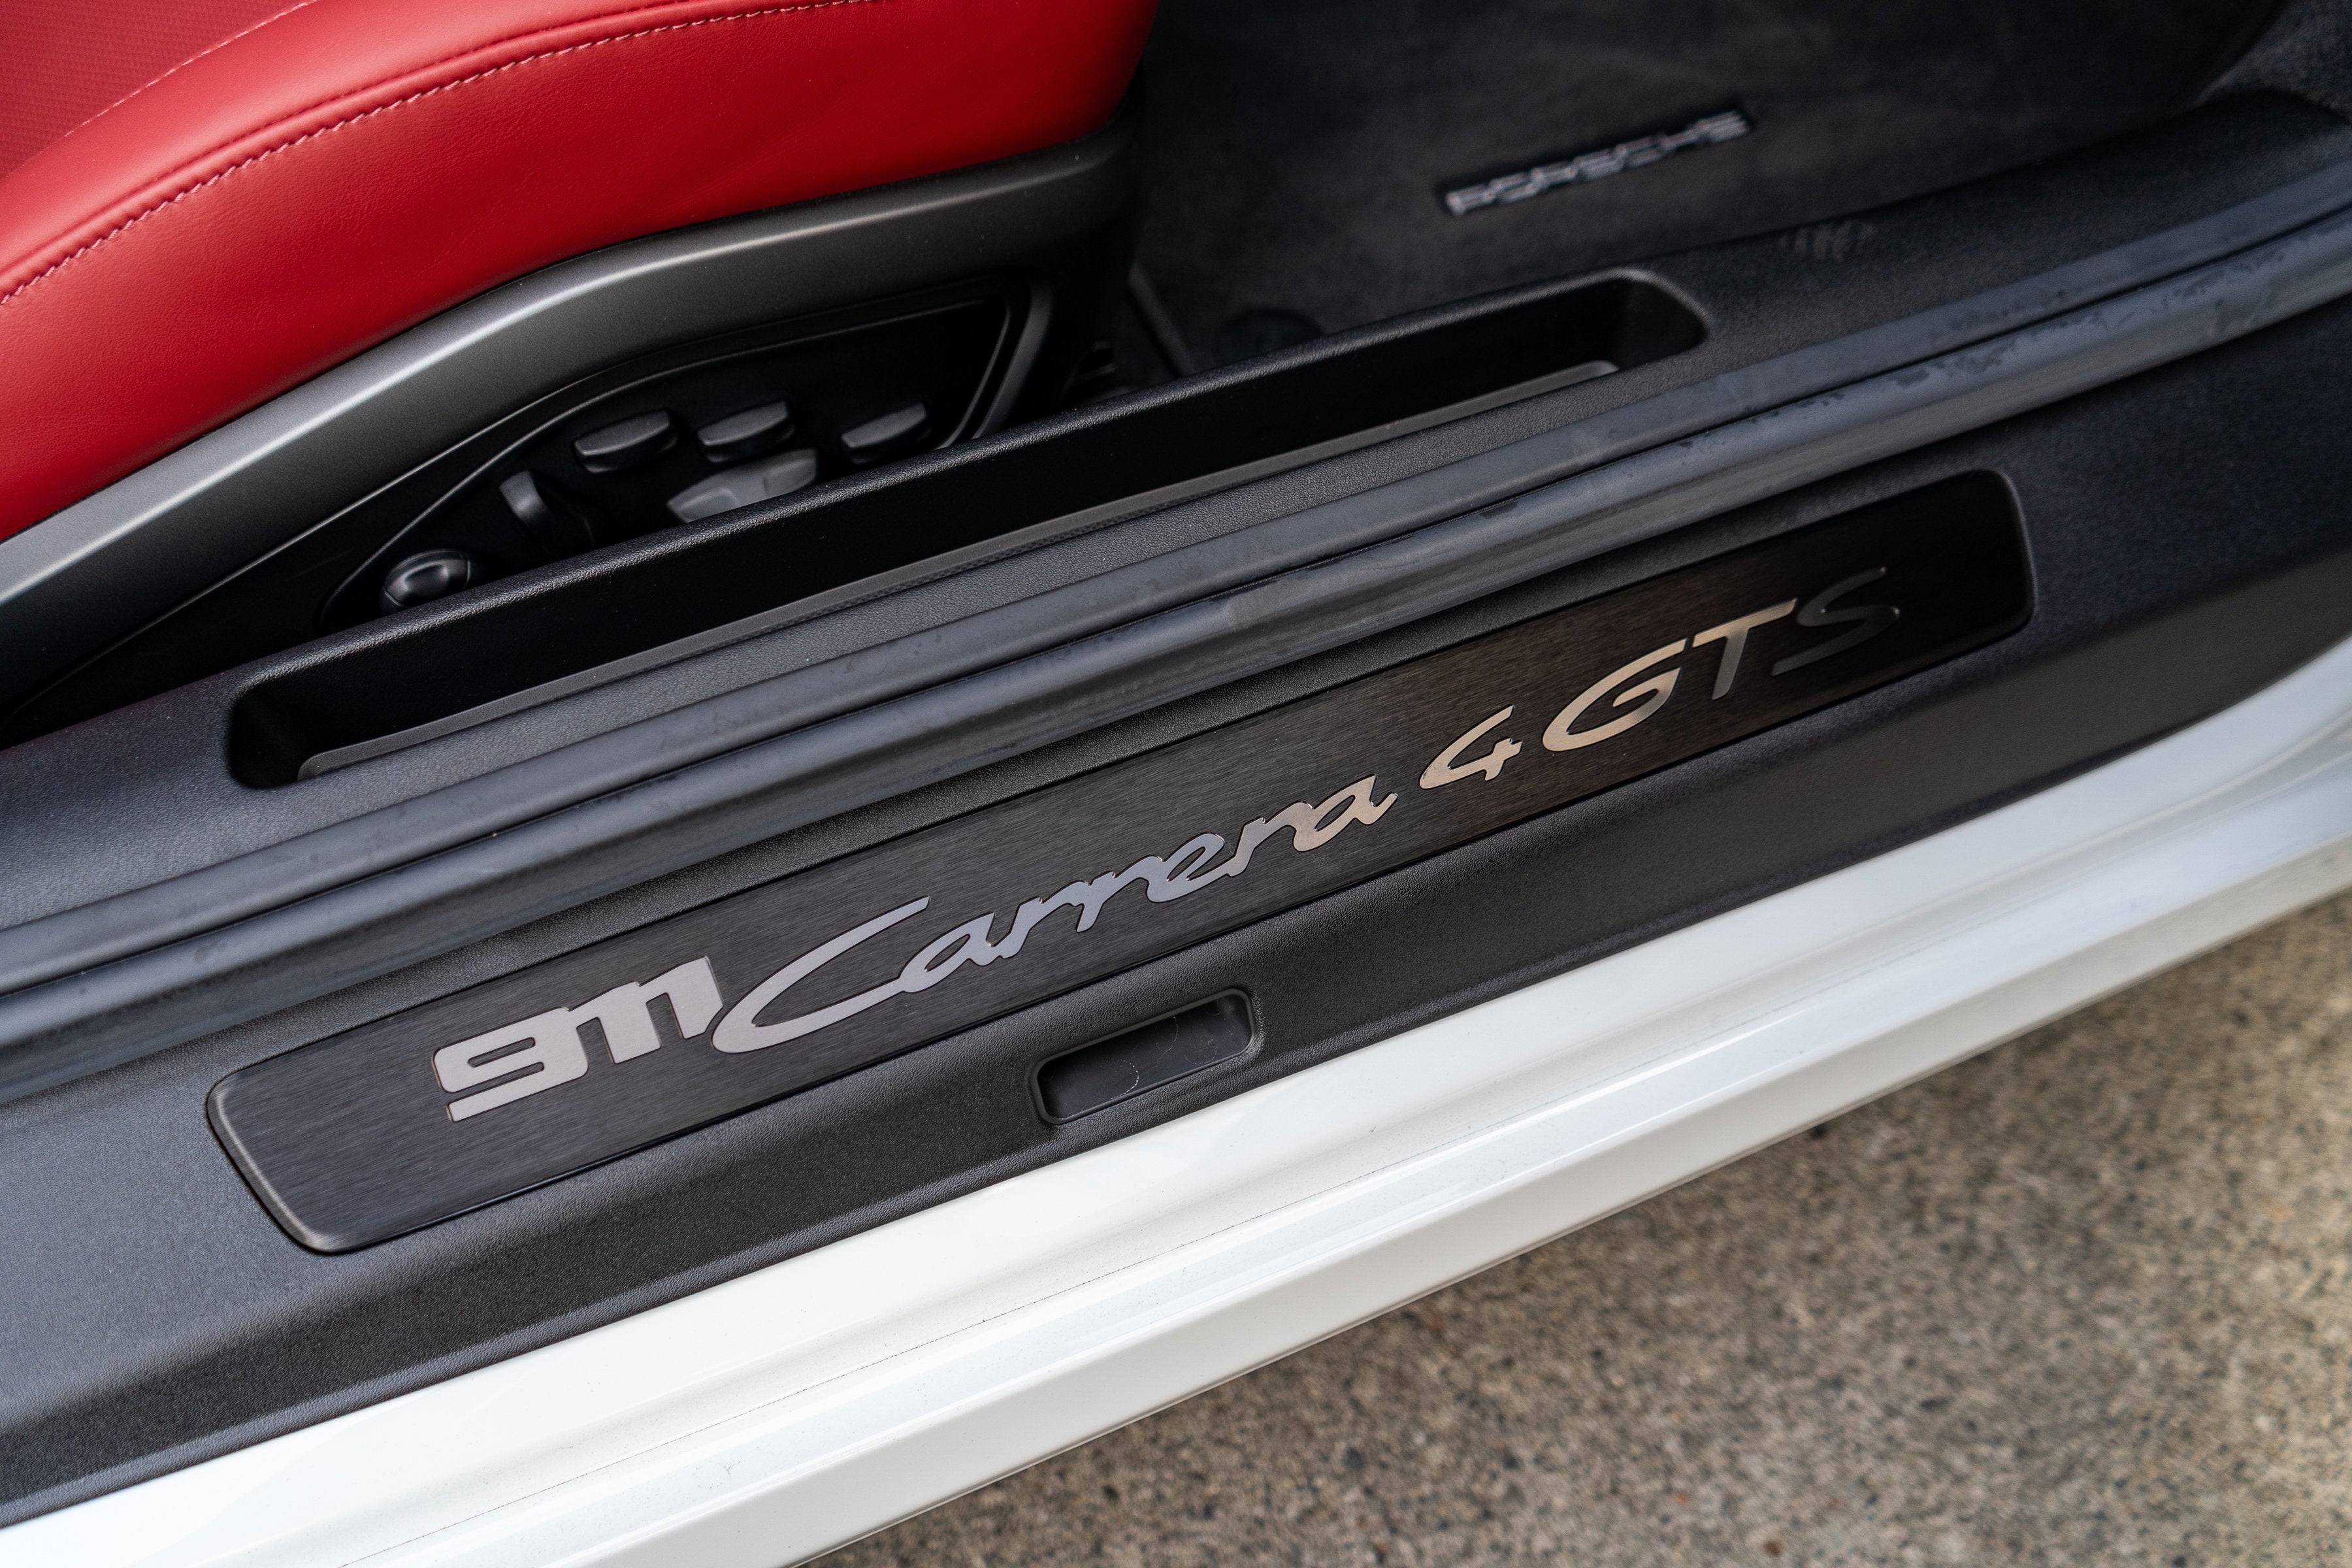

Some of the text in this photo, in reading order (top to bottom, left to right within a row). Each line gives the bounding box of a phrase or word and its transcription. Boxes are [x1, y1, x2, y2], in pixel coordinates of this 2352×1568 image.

[431, 566, 1901, 1122] 911 Carrera 4 GTS
